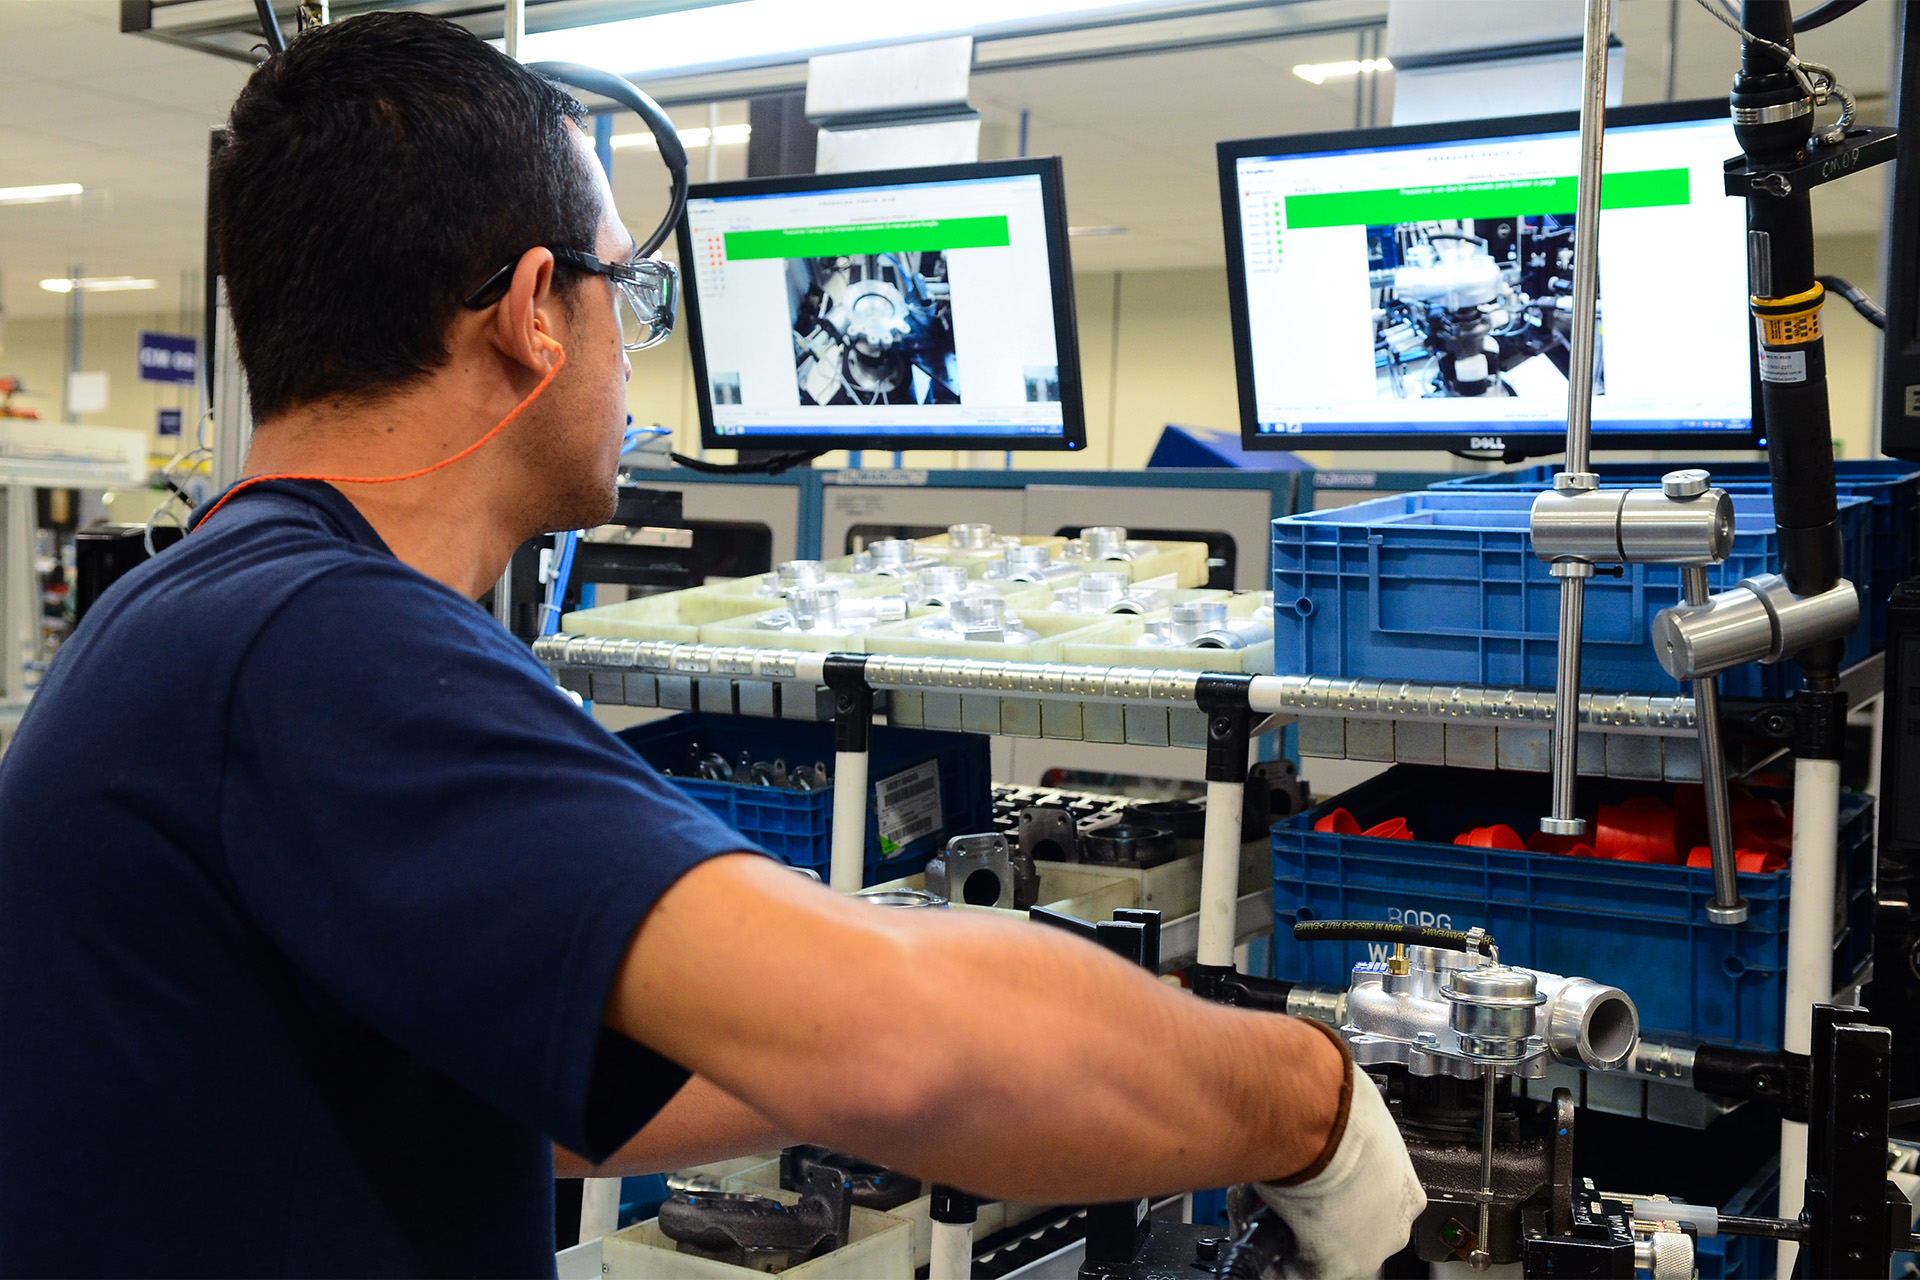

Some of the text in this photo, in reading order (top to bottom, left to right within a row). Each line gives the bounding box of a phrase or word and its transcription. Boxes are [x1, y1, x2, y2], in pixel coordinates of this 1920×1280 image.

[1822, 148, 1860, 178] CM09
[1470, 436, 1506, 449] DELL
[1384, 924, 1404, 932] MAN
[1387, 906, 1452, 931] BORG
